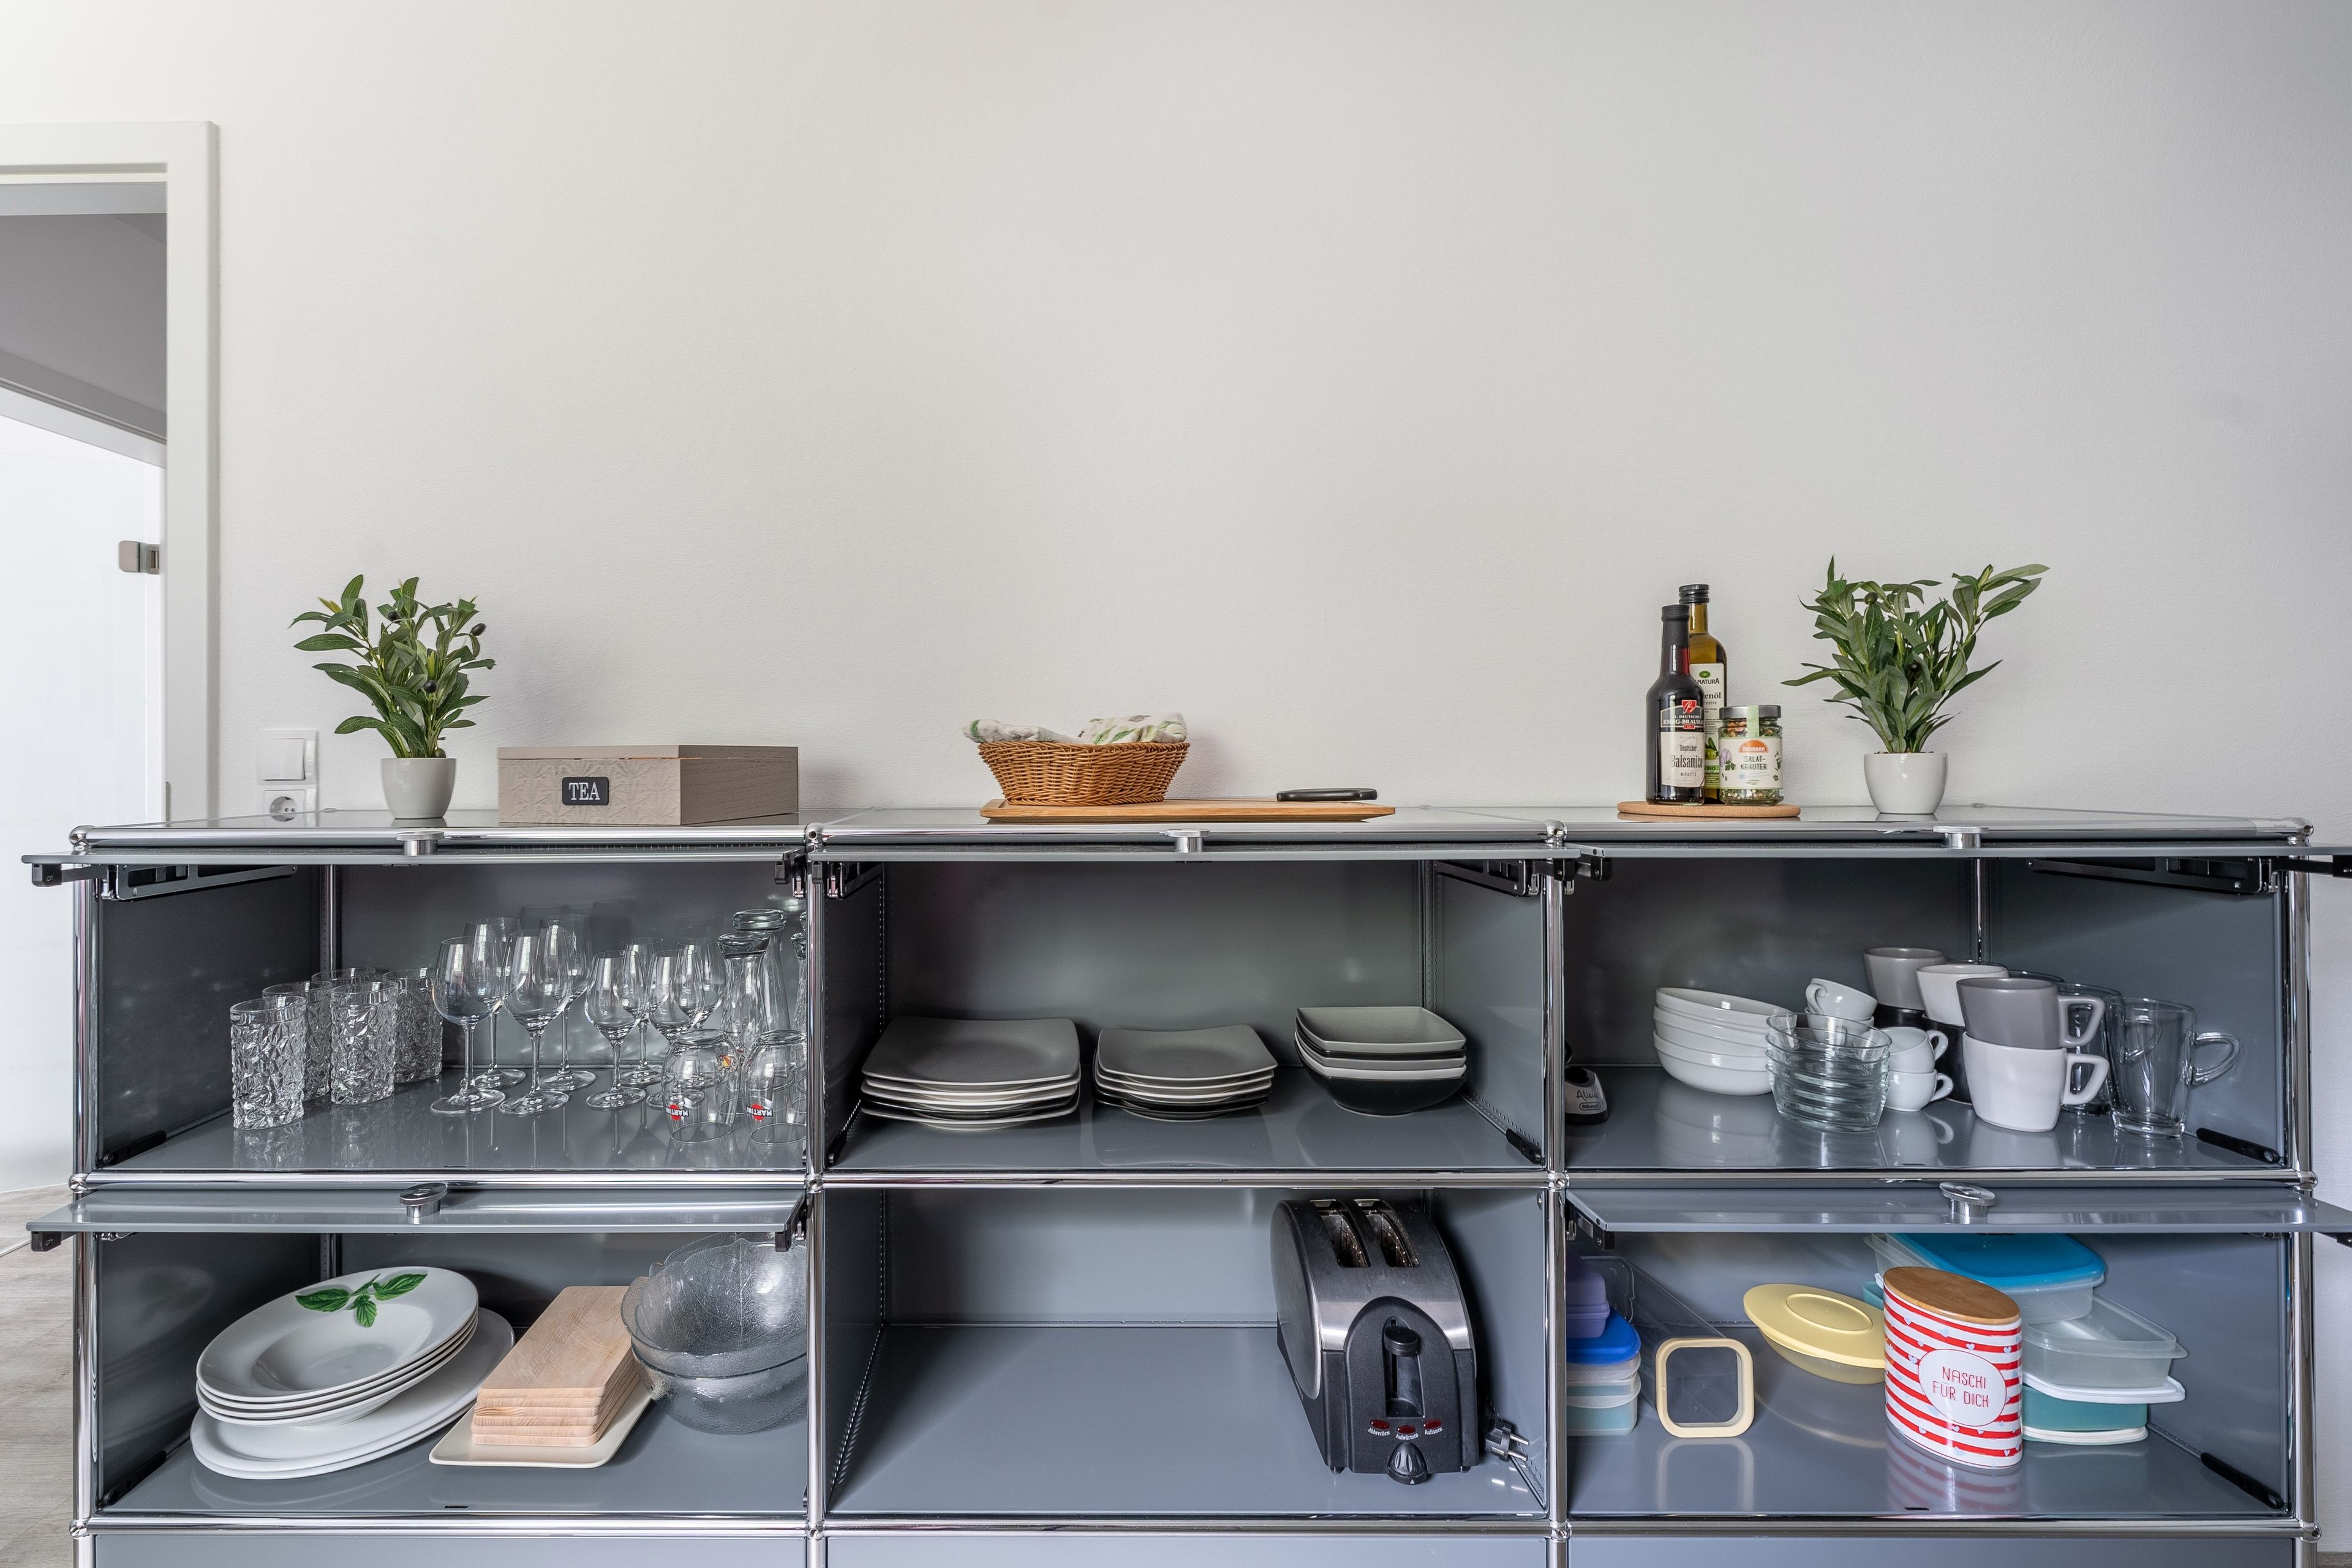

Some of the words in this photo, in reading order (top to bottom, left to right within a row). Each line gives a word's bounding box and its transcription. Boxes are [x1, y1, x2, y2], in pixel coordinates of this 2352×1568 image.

[1671, 755, 1703, 768] Balsamico
[568, 782, 600, 801] TEA
[665, 1107, 689, 1117] MARTINI
[746, 1106, 773, 1117] MARTINI
[1942, 1366, 1986, 1389] NASCHI
[1964, 1391, 1989, 1408] DICH
[1367, 1427, 1390, 1436] Abbrechen
